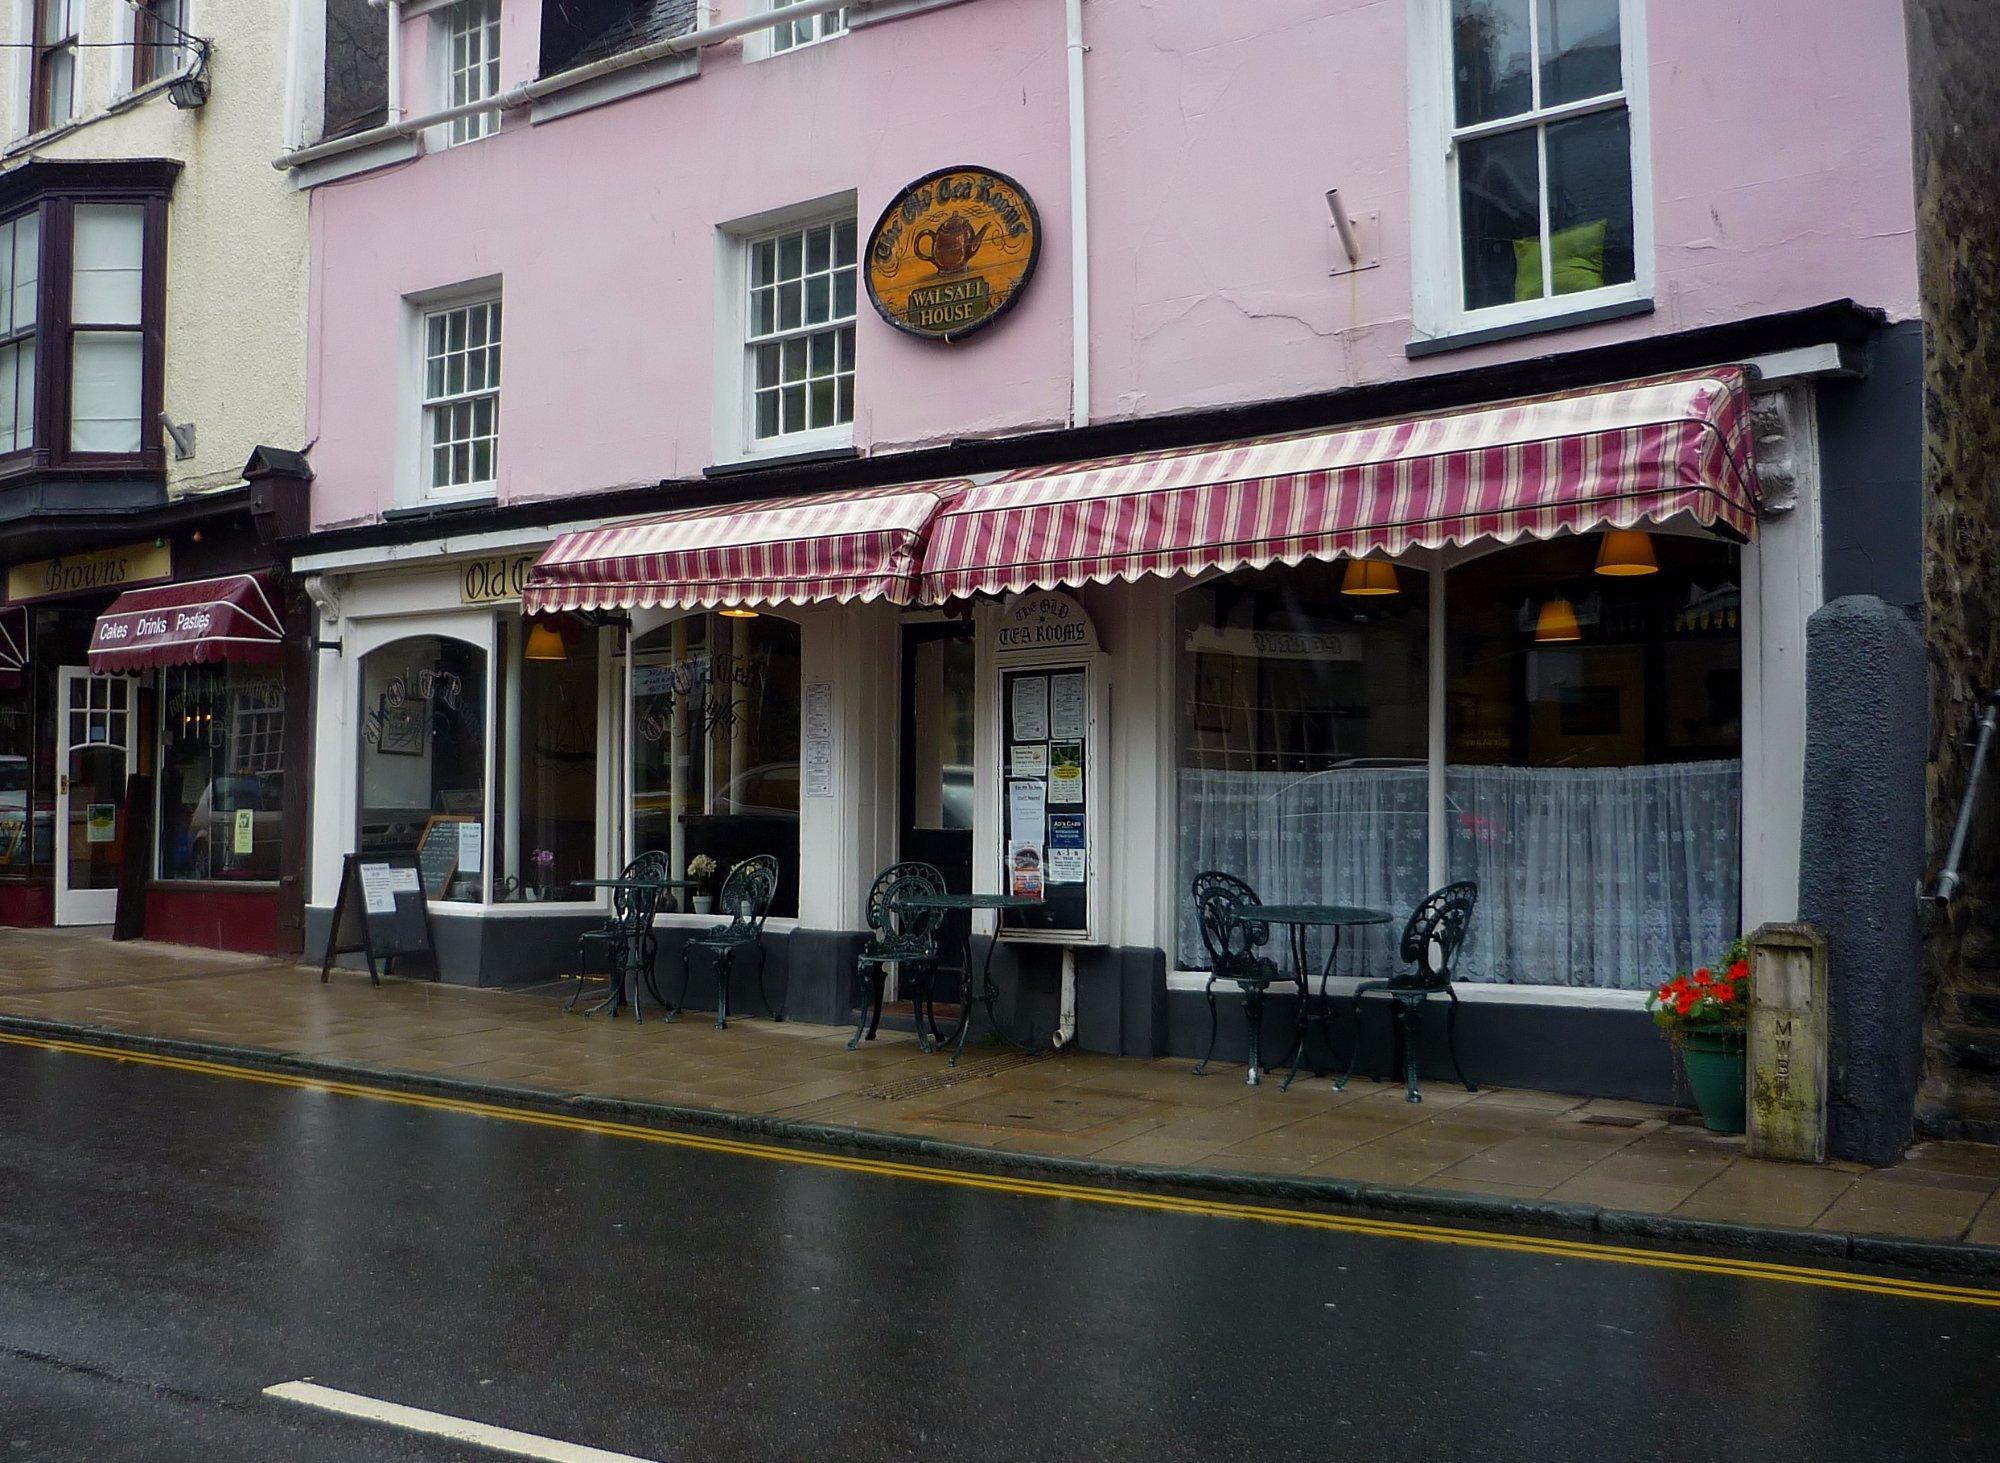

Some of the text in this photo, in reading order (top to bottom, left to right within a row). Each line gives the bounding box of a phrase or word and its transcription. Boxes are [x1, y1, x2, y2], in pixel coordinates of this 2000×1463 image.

[911, 280, 985, 308] WALSALL
[919, 302, 974, 326] HOUSE
[46, 559, 128, 591] Browns
[466, 556, 534, 599] Old T
[99, 609, 211, 640] Cakes Drinks Pasties
[999, 622, 1086, 646] TEA ROOMS
